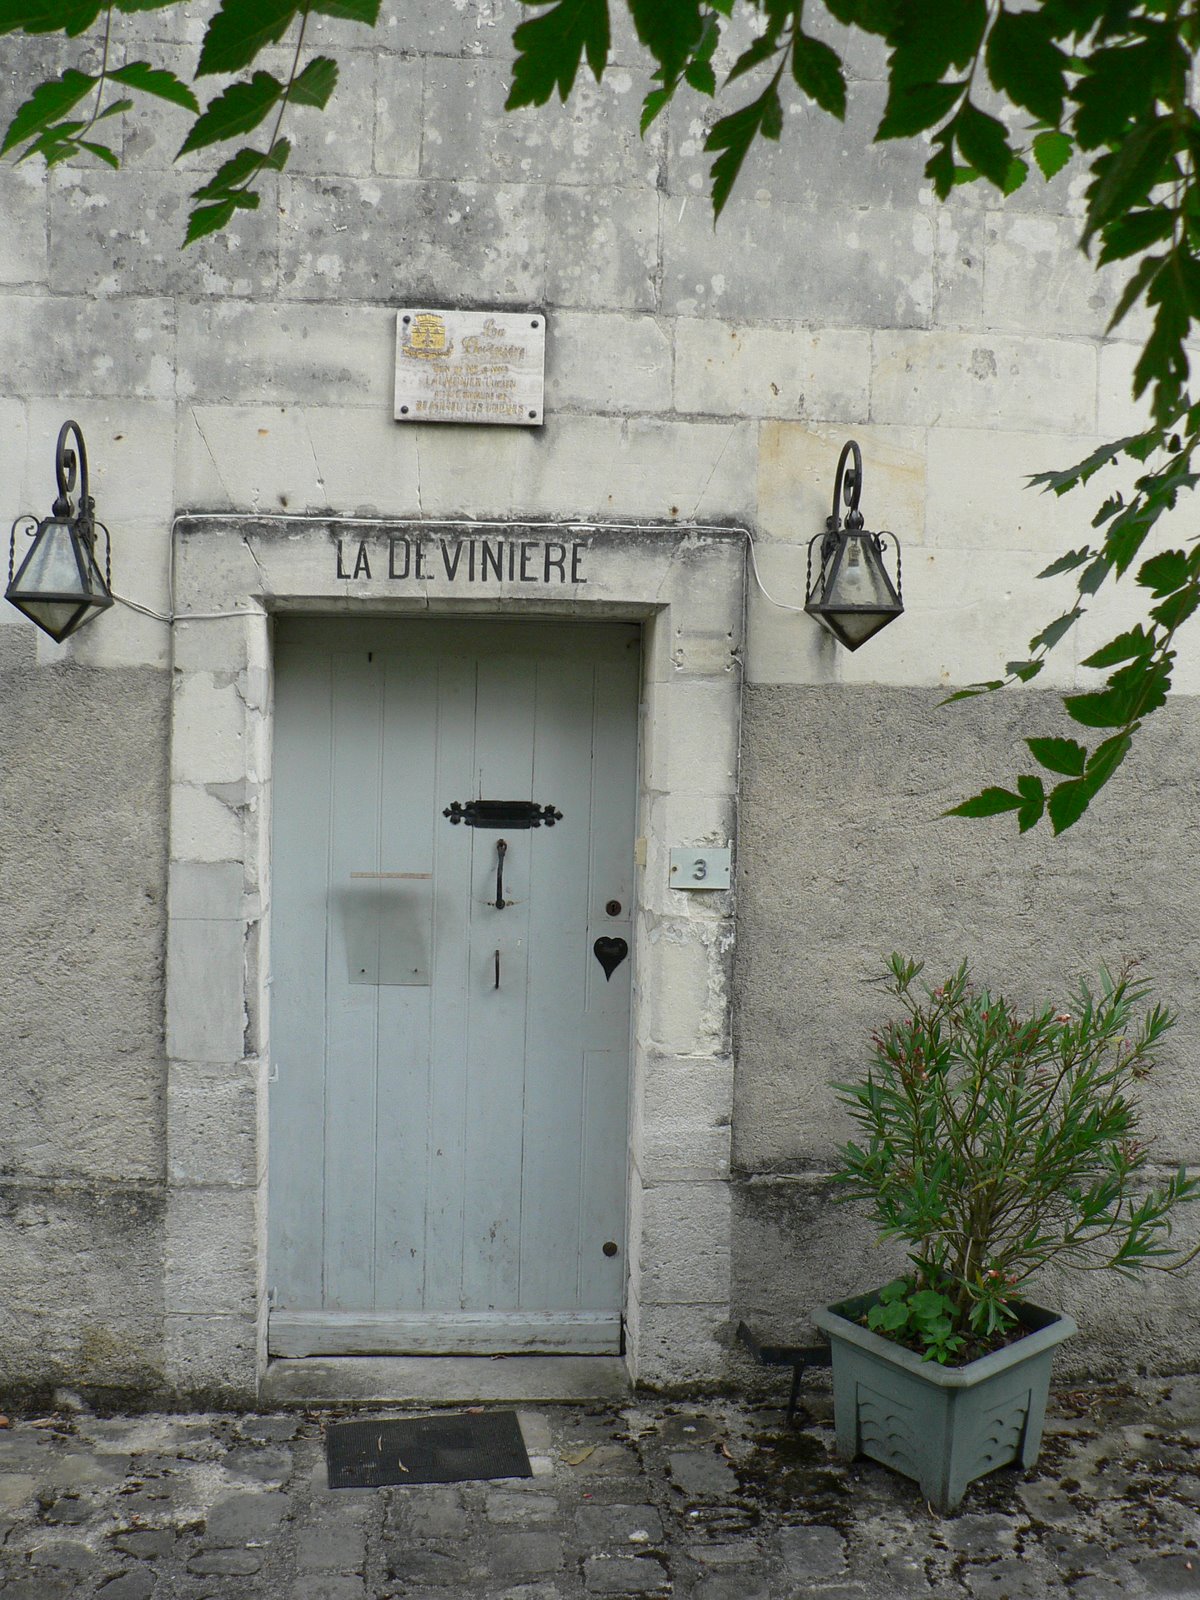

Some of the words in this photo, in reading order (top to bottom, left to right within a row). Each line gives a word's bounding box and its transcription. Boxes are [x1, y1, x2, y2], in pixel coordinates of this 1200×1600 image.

[336, 538, 372, 580] LA
[388, 537, 588, 583] DEVINIERE
[693, 859, 707, 880] 3
